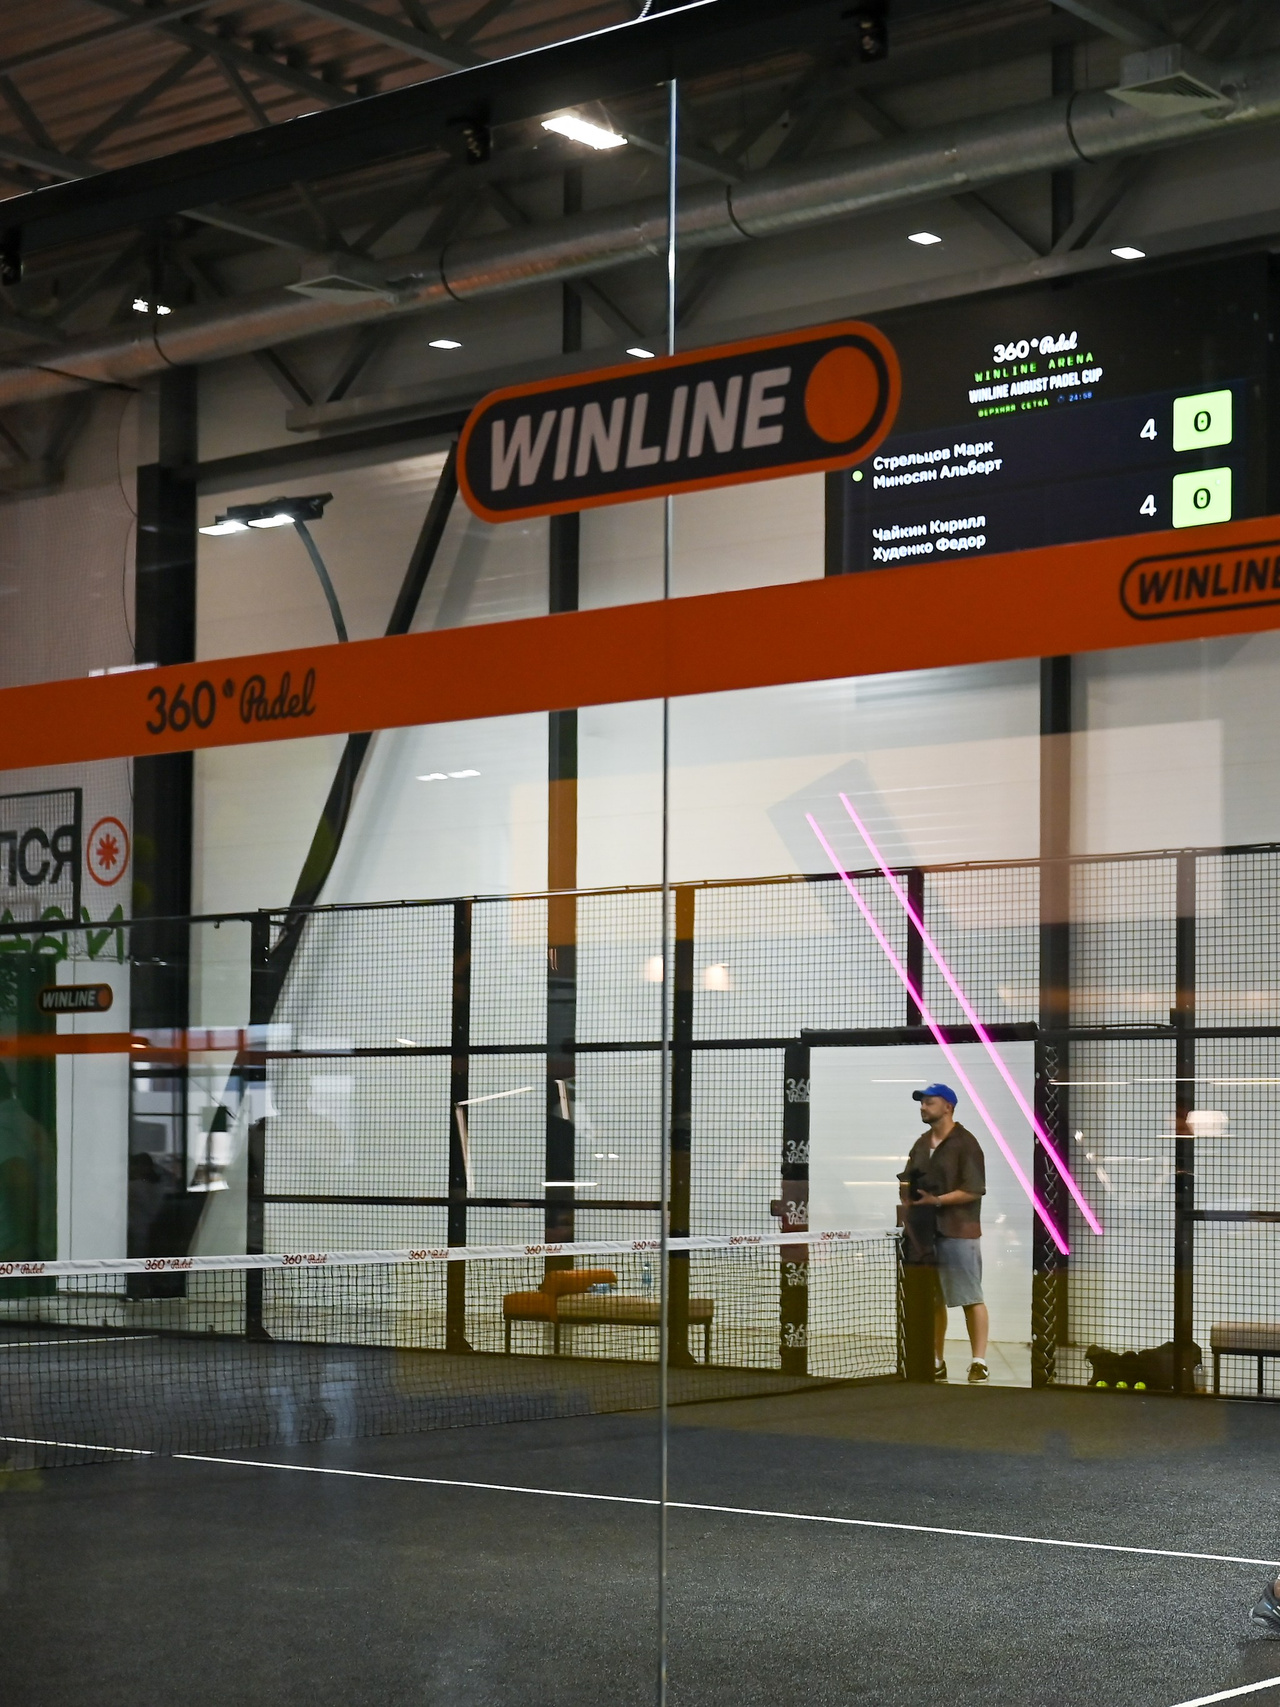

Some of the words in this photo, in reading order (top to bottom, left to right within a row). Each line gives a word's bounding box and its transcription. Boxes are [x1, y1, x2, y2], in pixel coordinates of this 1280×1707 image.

[1039, 331, 1078, 355] Padel
[974, 362, 1037, 382] WINLINE
[1048, 352, 1093, 369] ARENA
[968, 384, 1009, 404] WINLINE
[1010, 377, 1049, 397] AUGUST
[1050, 372, 1081, 390] PADEL
[1081, 367, 1103, 384] CUP
[491, 366, 791, 491] WINLINE
[1140, 418, 1157, 440] 4
[1193, 410, 1211, 432] 0
[873, 448, 951, 471] Стрельцов
[953, 441, 994, 457] Марк
[873, 469, 937, 489] Миносян
[940, 459, 1002, 479] Альберт
[1139, 494, 1157, 516] 4
[1193, 488, 1211, 509] 0
[872, 525, 927, 541] Чайкин
[930, 515, 986, 534] Кирилл
[873, 542, 934, 562] Худенко
[936, 534, 986, 551] Федор
[240, 667, 316, 723] Padel
[42, 989, 97, 1009] WINLINE
